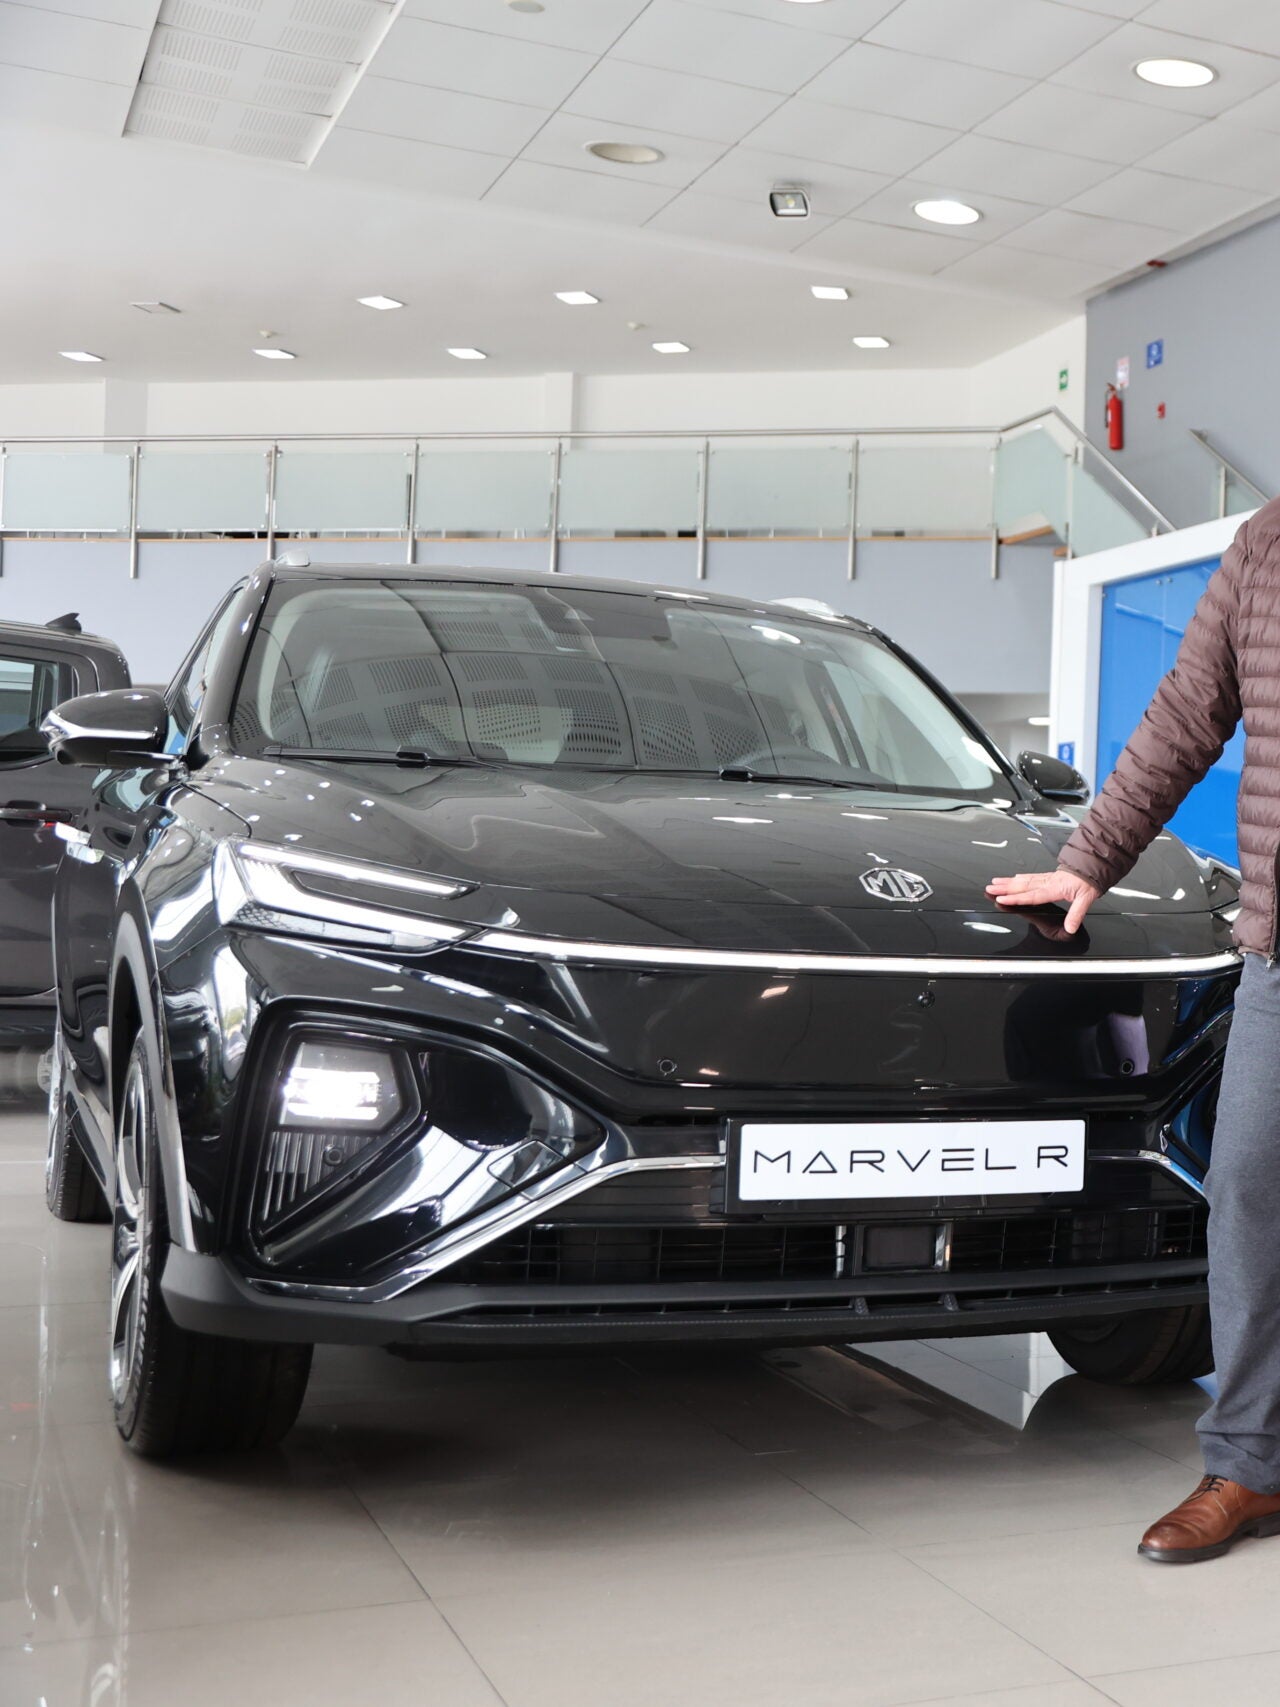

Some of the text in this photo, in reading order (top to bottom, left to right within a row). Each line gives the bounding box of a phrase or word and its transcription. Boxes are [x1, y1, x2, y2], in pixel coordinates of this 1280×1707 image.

[866, 870, 926, 898] MG
[754, 1145, 1069, 1174] MARVEL R
